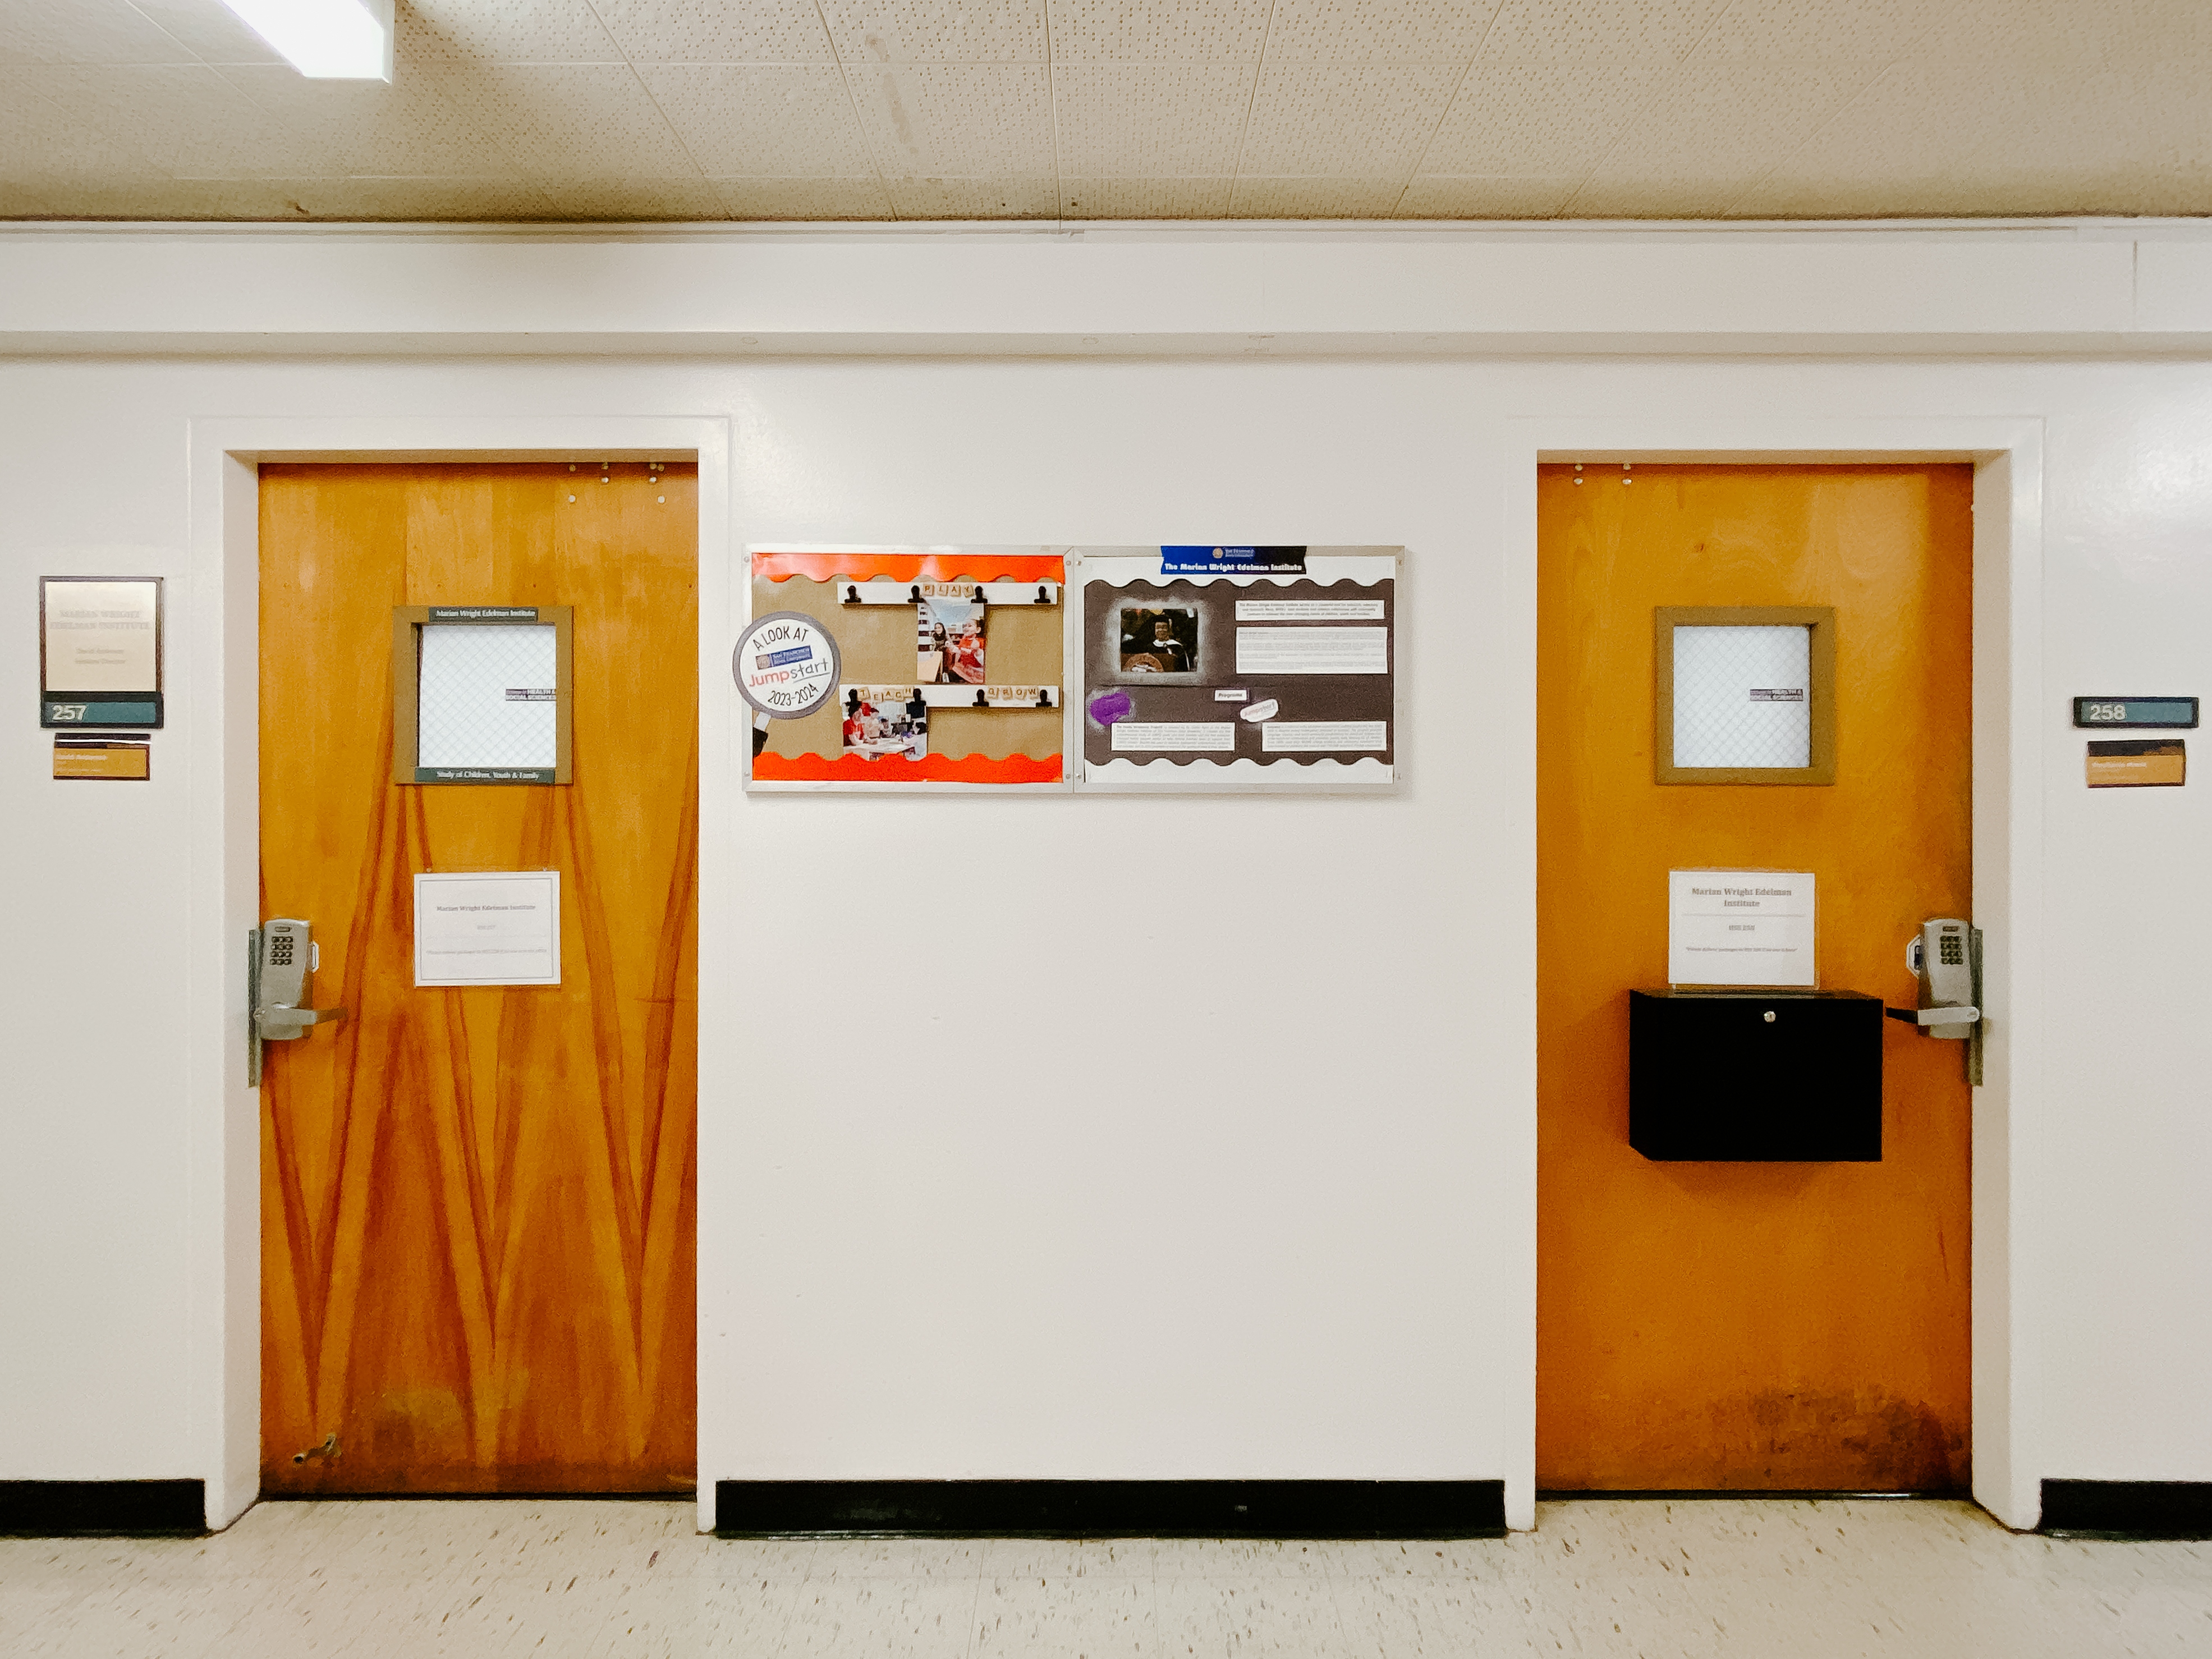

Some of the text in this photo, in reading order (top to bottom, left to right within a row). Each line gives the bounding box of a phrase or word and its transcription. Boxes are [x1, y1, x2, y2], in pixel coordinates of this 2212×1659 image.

[1209, 563, 1235, 572] Wright
[460, 609, 481, 618] Wright
[752, 626, 809, 651] A LOOK AT
[749, 658, 829, 687] Jumpstart
[768, 682, 819, 706] 2023-2024
[860, 688, 912, 700] TEACH
[52, 704, 88, 721] 257
[2090, 704, 2126, 721] 258
[1724, 888, 1752, 897] Wright
